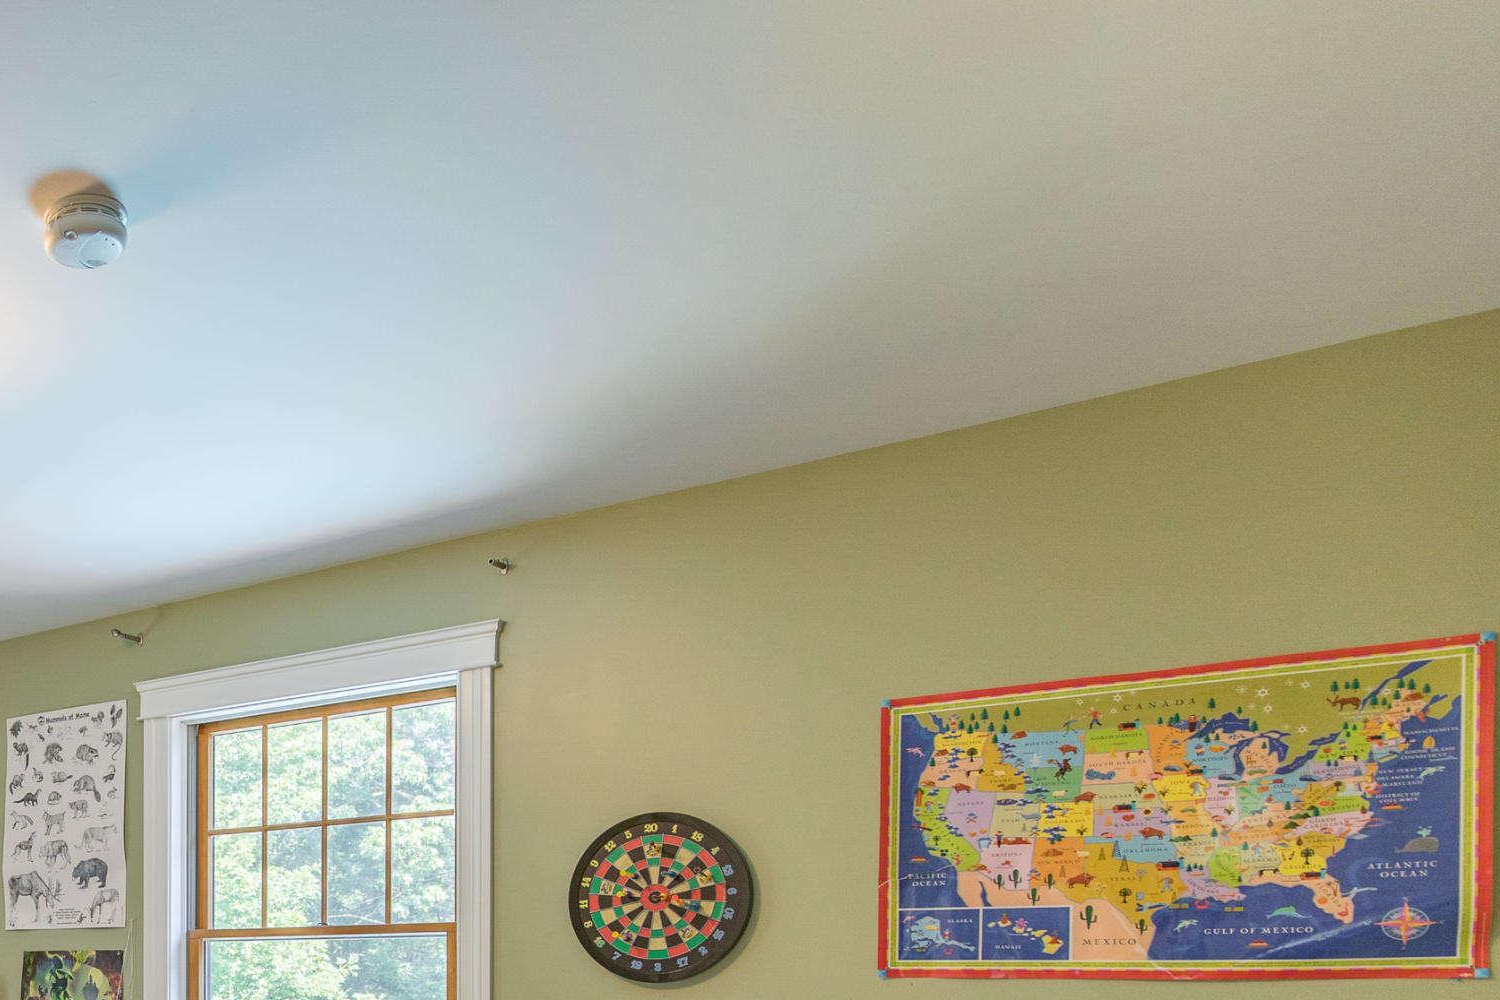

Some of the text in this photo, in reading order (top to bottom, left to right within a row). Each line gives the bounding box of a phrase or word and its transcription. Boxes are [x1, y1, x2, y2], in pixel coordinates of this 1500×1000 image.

[1123, 698, 1196, 712] CANADA
[643, 823, 659, 833] 20
[671, 824, 678, 834] 1
[624, 831, 633, 839] 5
[690, 830, 705, 843] 18
[604, 840, 617, 852] 12
[711, 846, 720, 856] 4
[1367, 860, 1438, 870] ATLANTIC
[907, 872, 947, 880] PACIFIC
[1379, 869, 1428, 879] OCEAN
[581, 877, 592, 888] 14
[579, 899, 589, 909] 11
[584, 920, 593, 929] 8
[1261, 926, 1315, 935] MEXICO
[1082, 937, 1137, 946] MEXICO
[612, 951, 622, 961] 7
